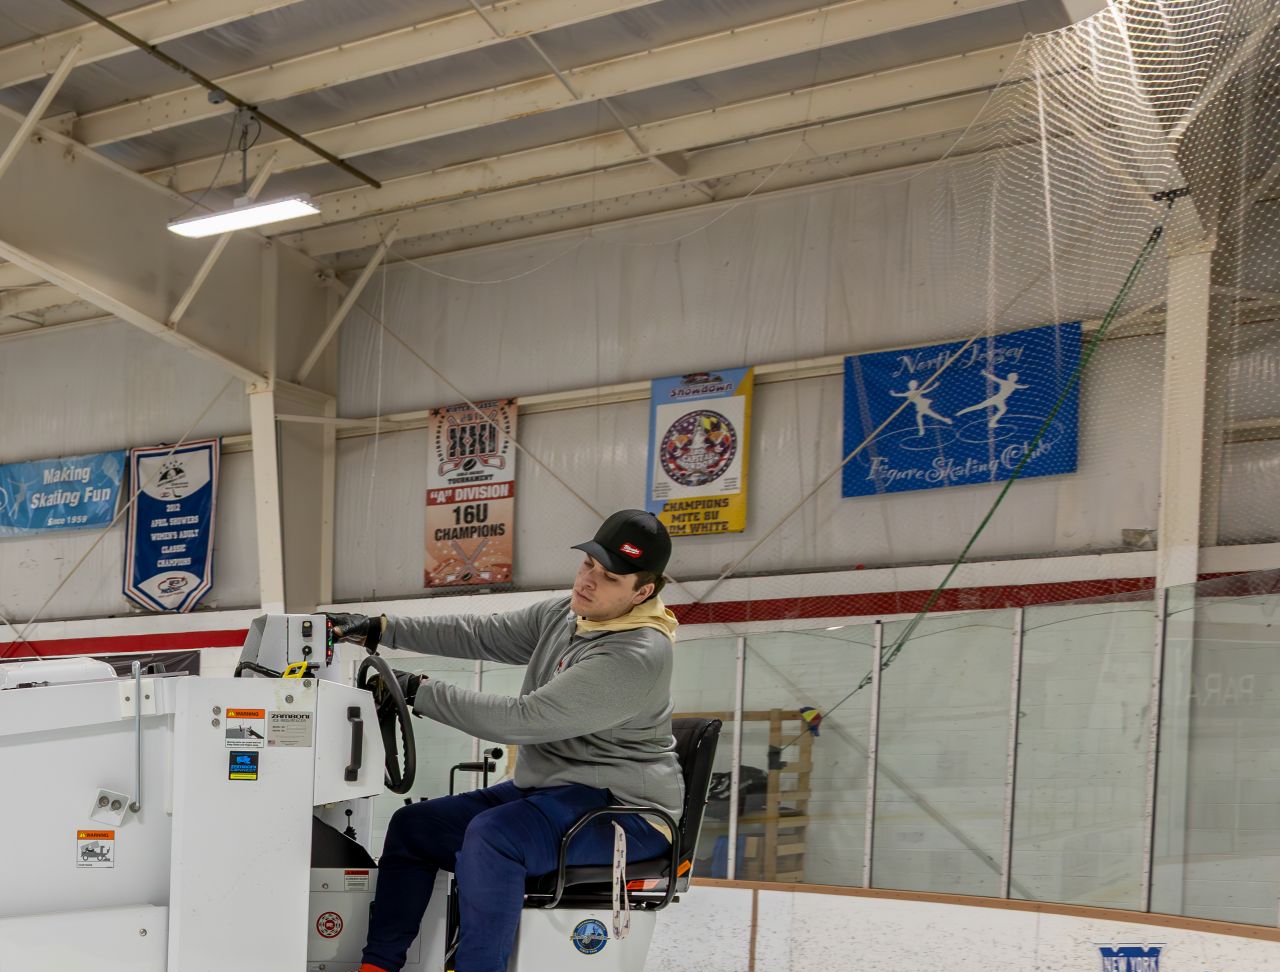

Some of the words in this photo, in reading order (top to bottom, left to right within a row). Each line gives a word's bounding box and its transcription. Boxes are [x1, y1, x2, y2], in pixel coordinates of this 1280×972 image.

[43, 466, 92, 485] Making
[865, 457, 926, 487] Figure
[925, 456, 999, 483] Skating
[31, 490, 81, 509] Skating
[83, 487, 112, 503] Fun
[455, 484, 509, 501] DIVISION
[662, 498, 729, 512] CHAMPIONS
[47, 517, 66, 526] Since
[452, 503, 488, 525] 16U
[671, 512, 701, 523] MITE
[434, 523, 506, 541] CHAMPIONS
[690, 521, 729, 533] WHITE
[1104, 956, 1128, 972] NEW
